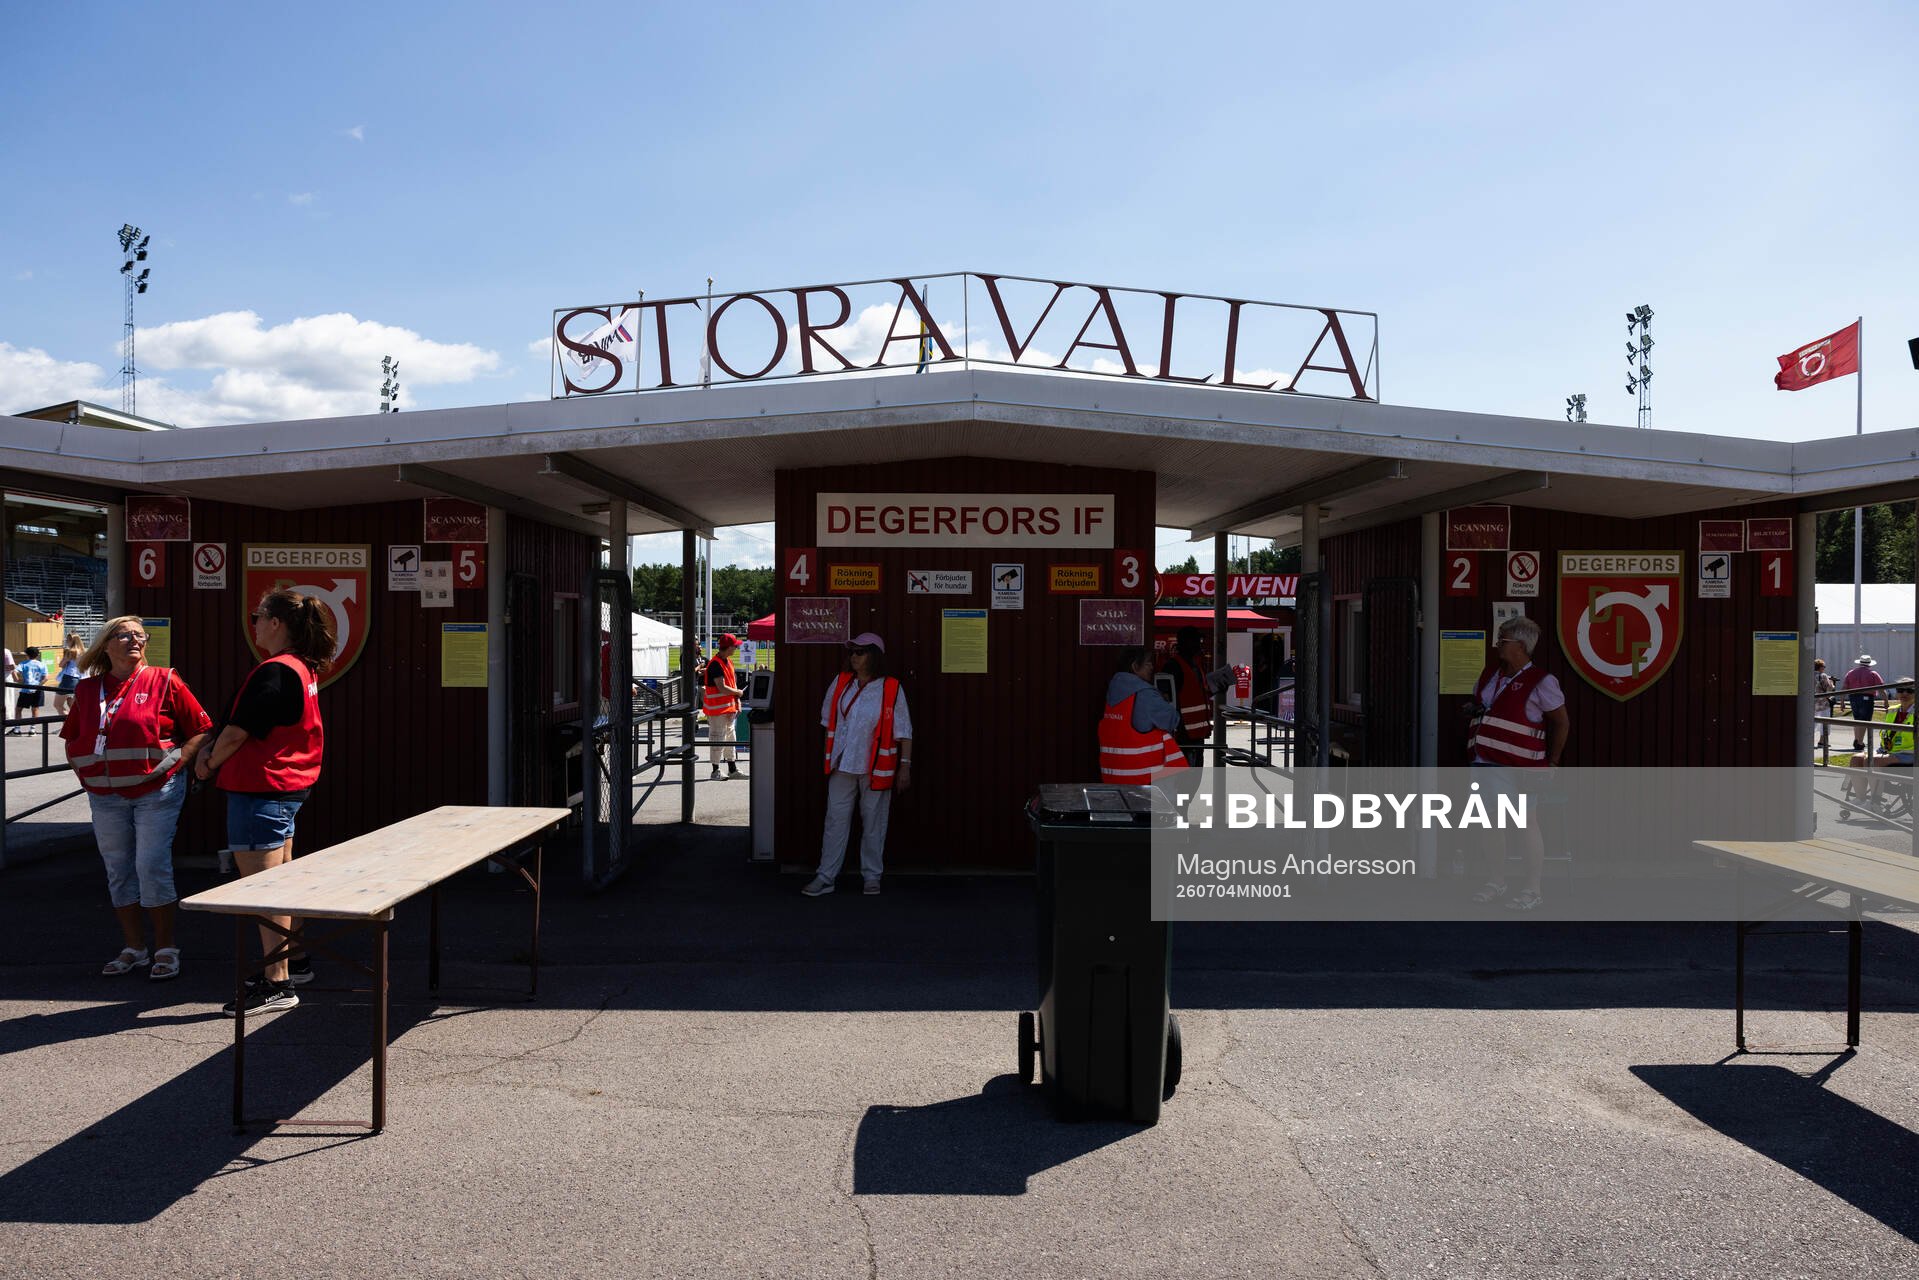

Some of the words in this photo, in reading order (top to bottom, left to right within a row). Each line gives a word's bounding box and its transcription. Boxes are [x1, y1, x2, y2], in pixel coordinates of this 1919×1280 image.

[556, 278, 967, 396] STORA
[973, 272, 1376, 400] VALLA
[131, 513, 184, 524] SCANNING
[430, 515, 481, 525] SCANNING
[827, 505, 1061, 536] DEGERFORS
[1073, 507, 1105, 535] IF
[1453, 523, 1504, 533] SCANNING
[251, 551, 363, 565] DEGERFORS
[138, 548, 157, 581] 6
[458, 549, 478, 582] 5
[789, 553, 810, 586] 4
[1566, 558, 1676, 571] DEGERFORS
[837, 568, 874, 579] Rökning
[1056, 569, 1094, 580] Rökning
[1120, 556, 1140, 588] 3
[1451, 557, 1471, 589] 2
[1767, 557, 1781, 589] 1
[834, 577, 876, 588] förbjuden
[935, 573, 967, 584] Förbjudet
[1054, 578, 1097, 589] förbjuden
[934, 581, 944, 590] för
[945, 581, 968, 590] hundar
[792, 622, 843, 631] SCANNING
[1086, 623, 1136, 632] SCANNING
